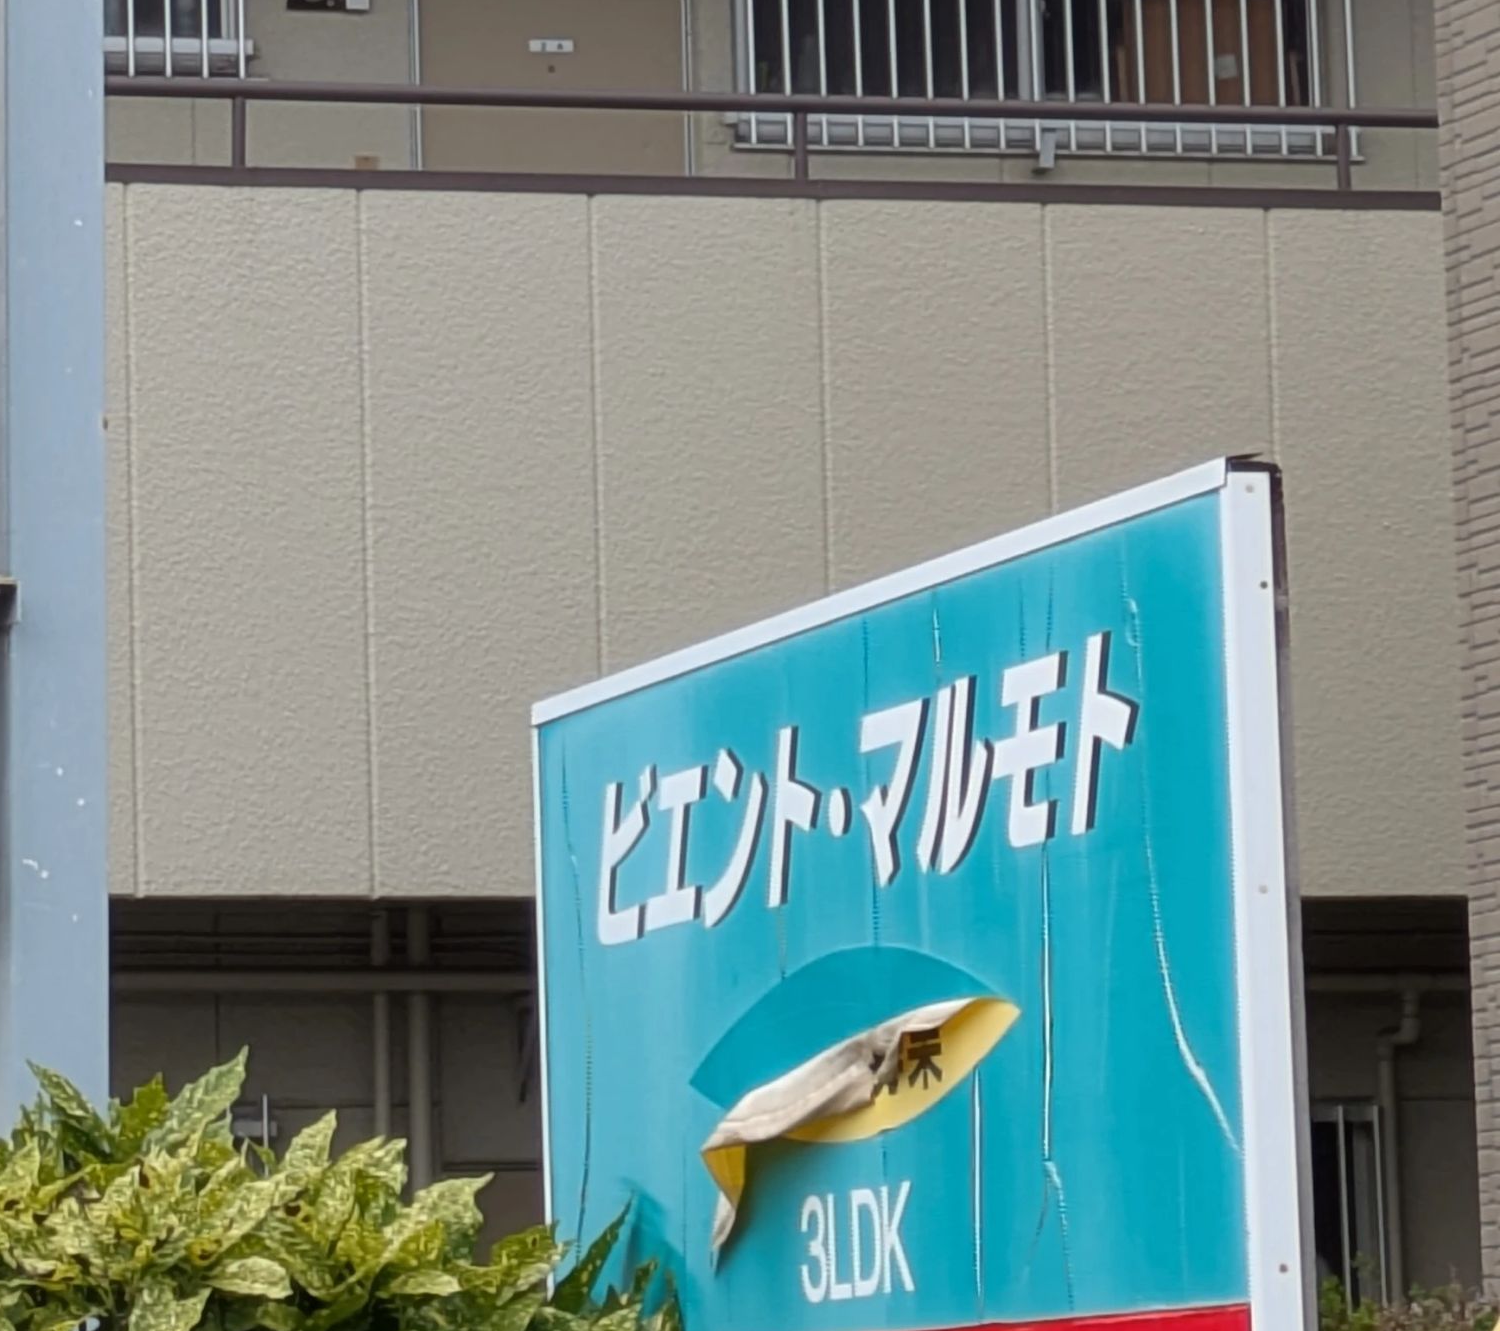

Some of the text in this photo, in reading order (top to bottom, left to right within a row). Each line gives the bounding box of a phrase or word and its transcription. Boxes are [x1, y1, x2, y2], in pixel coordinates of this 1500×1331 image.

[598, 631, 1138, 945] ビエント・マルモト
[799, 1180, 914, 1304] 3LDK
